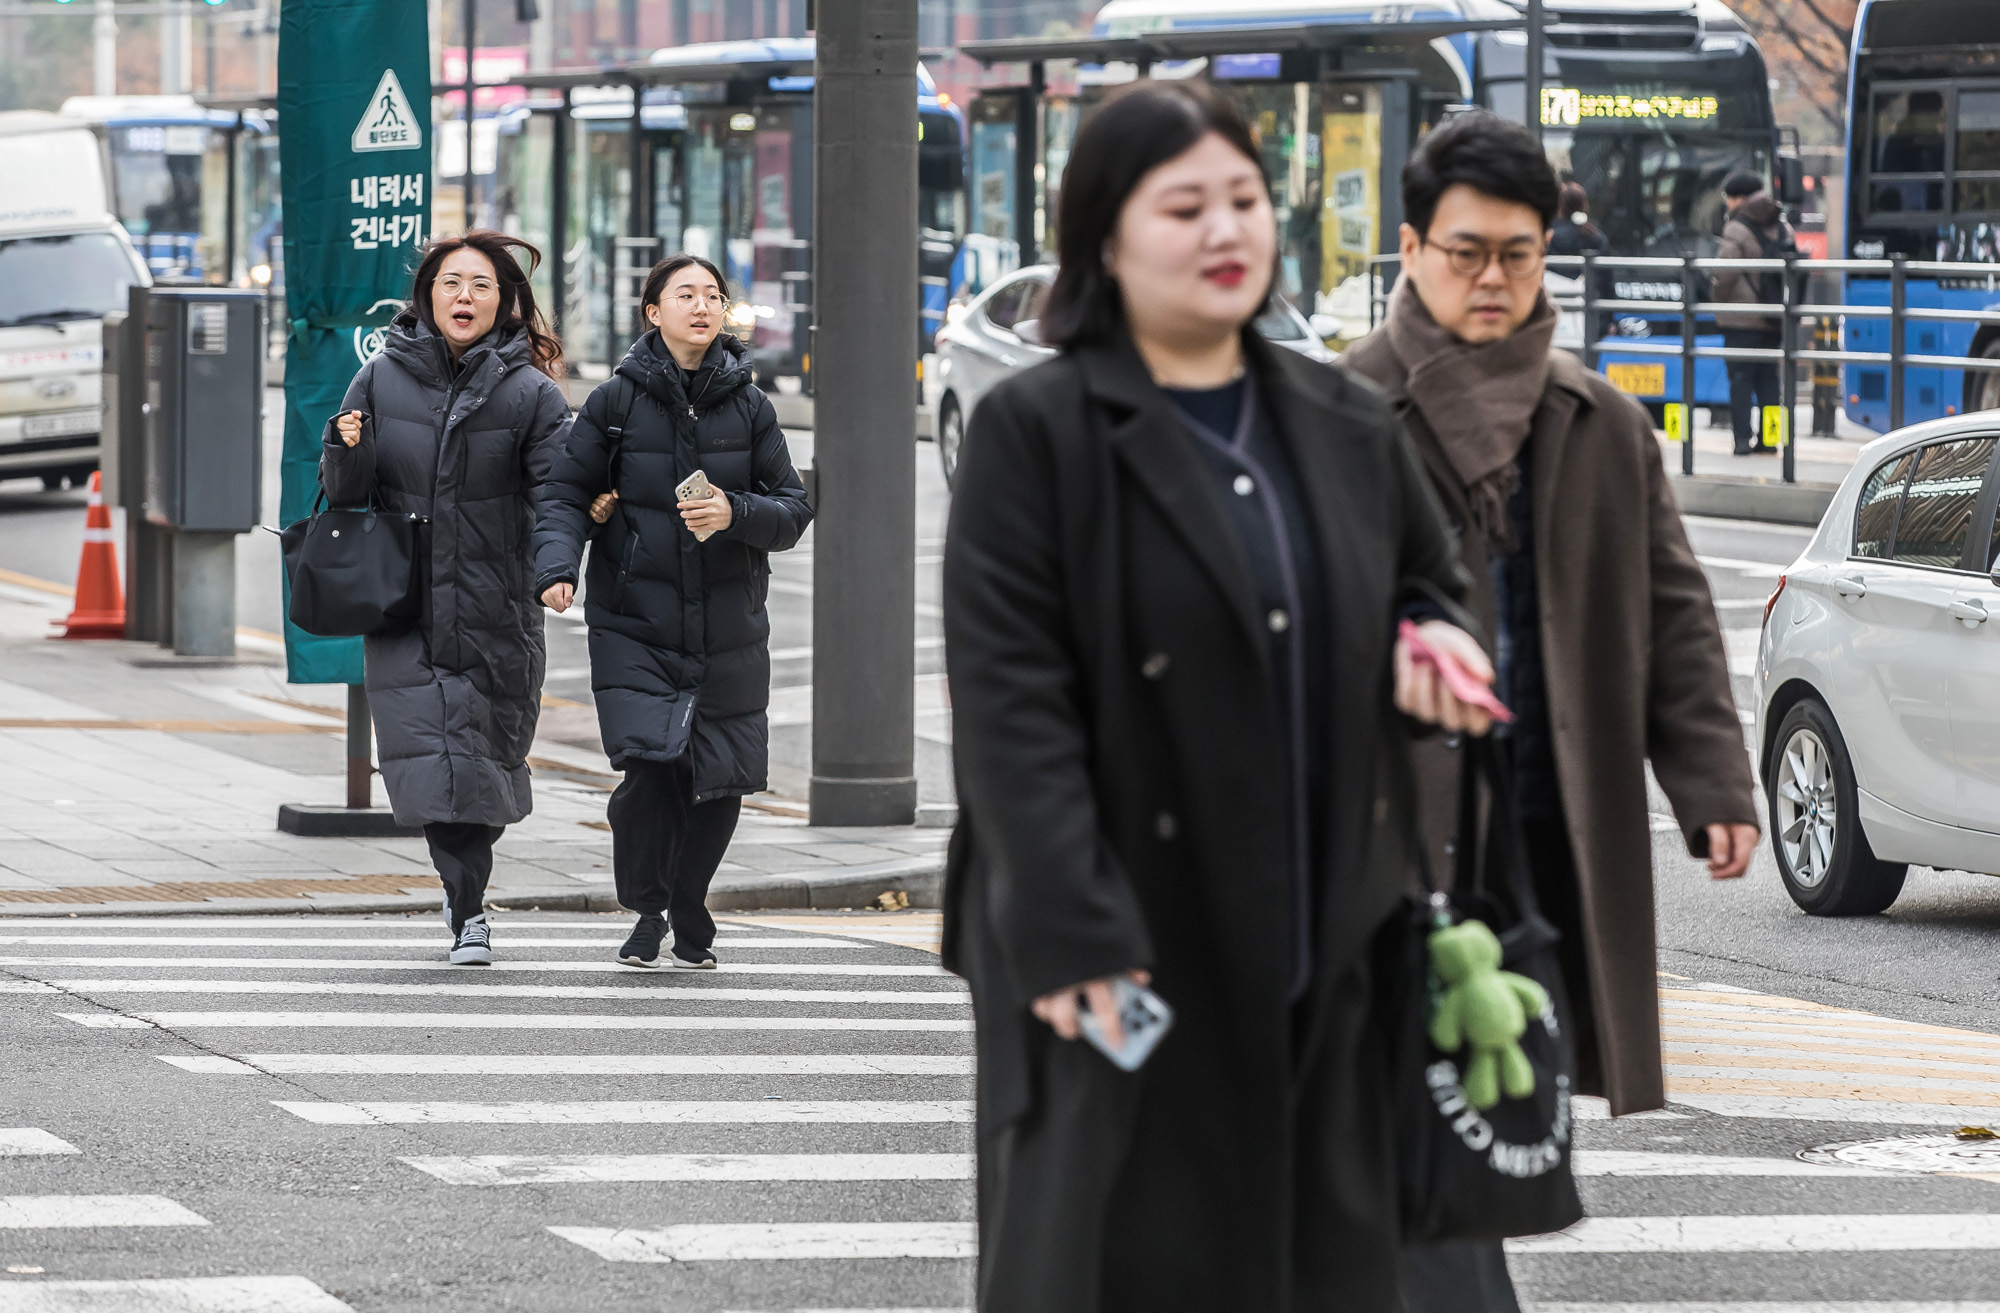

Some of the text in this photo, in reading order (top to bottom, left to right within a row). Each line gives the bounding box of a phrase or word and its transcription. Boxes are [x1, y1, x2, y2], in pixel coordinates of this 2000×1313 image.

[368, 129, 408, 144] 횡단보도
[350, 173, 424, 209] 내려서
[350, 213, 423, 250] 건너기
